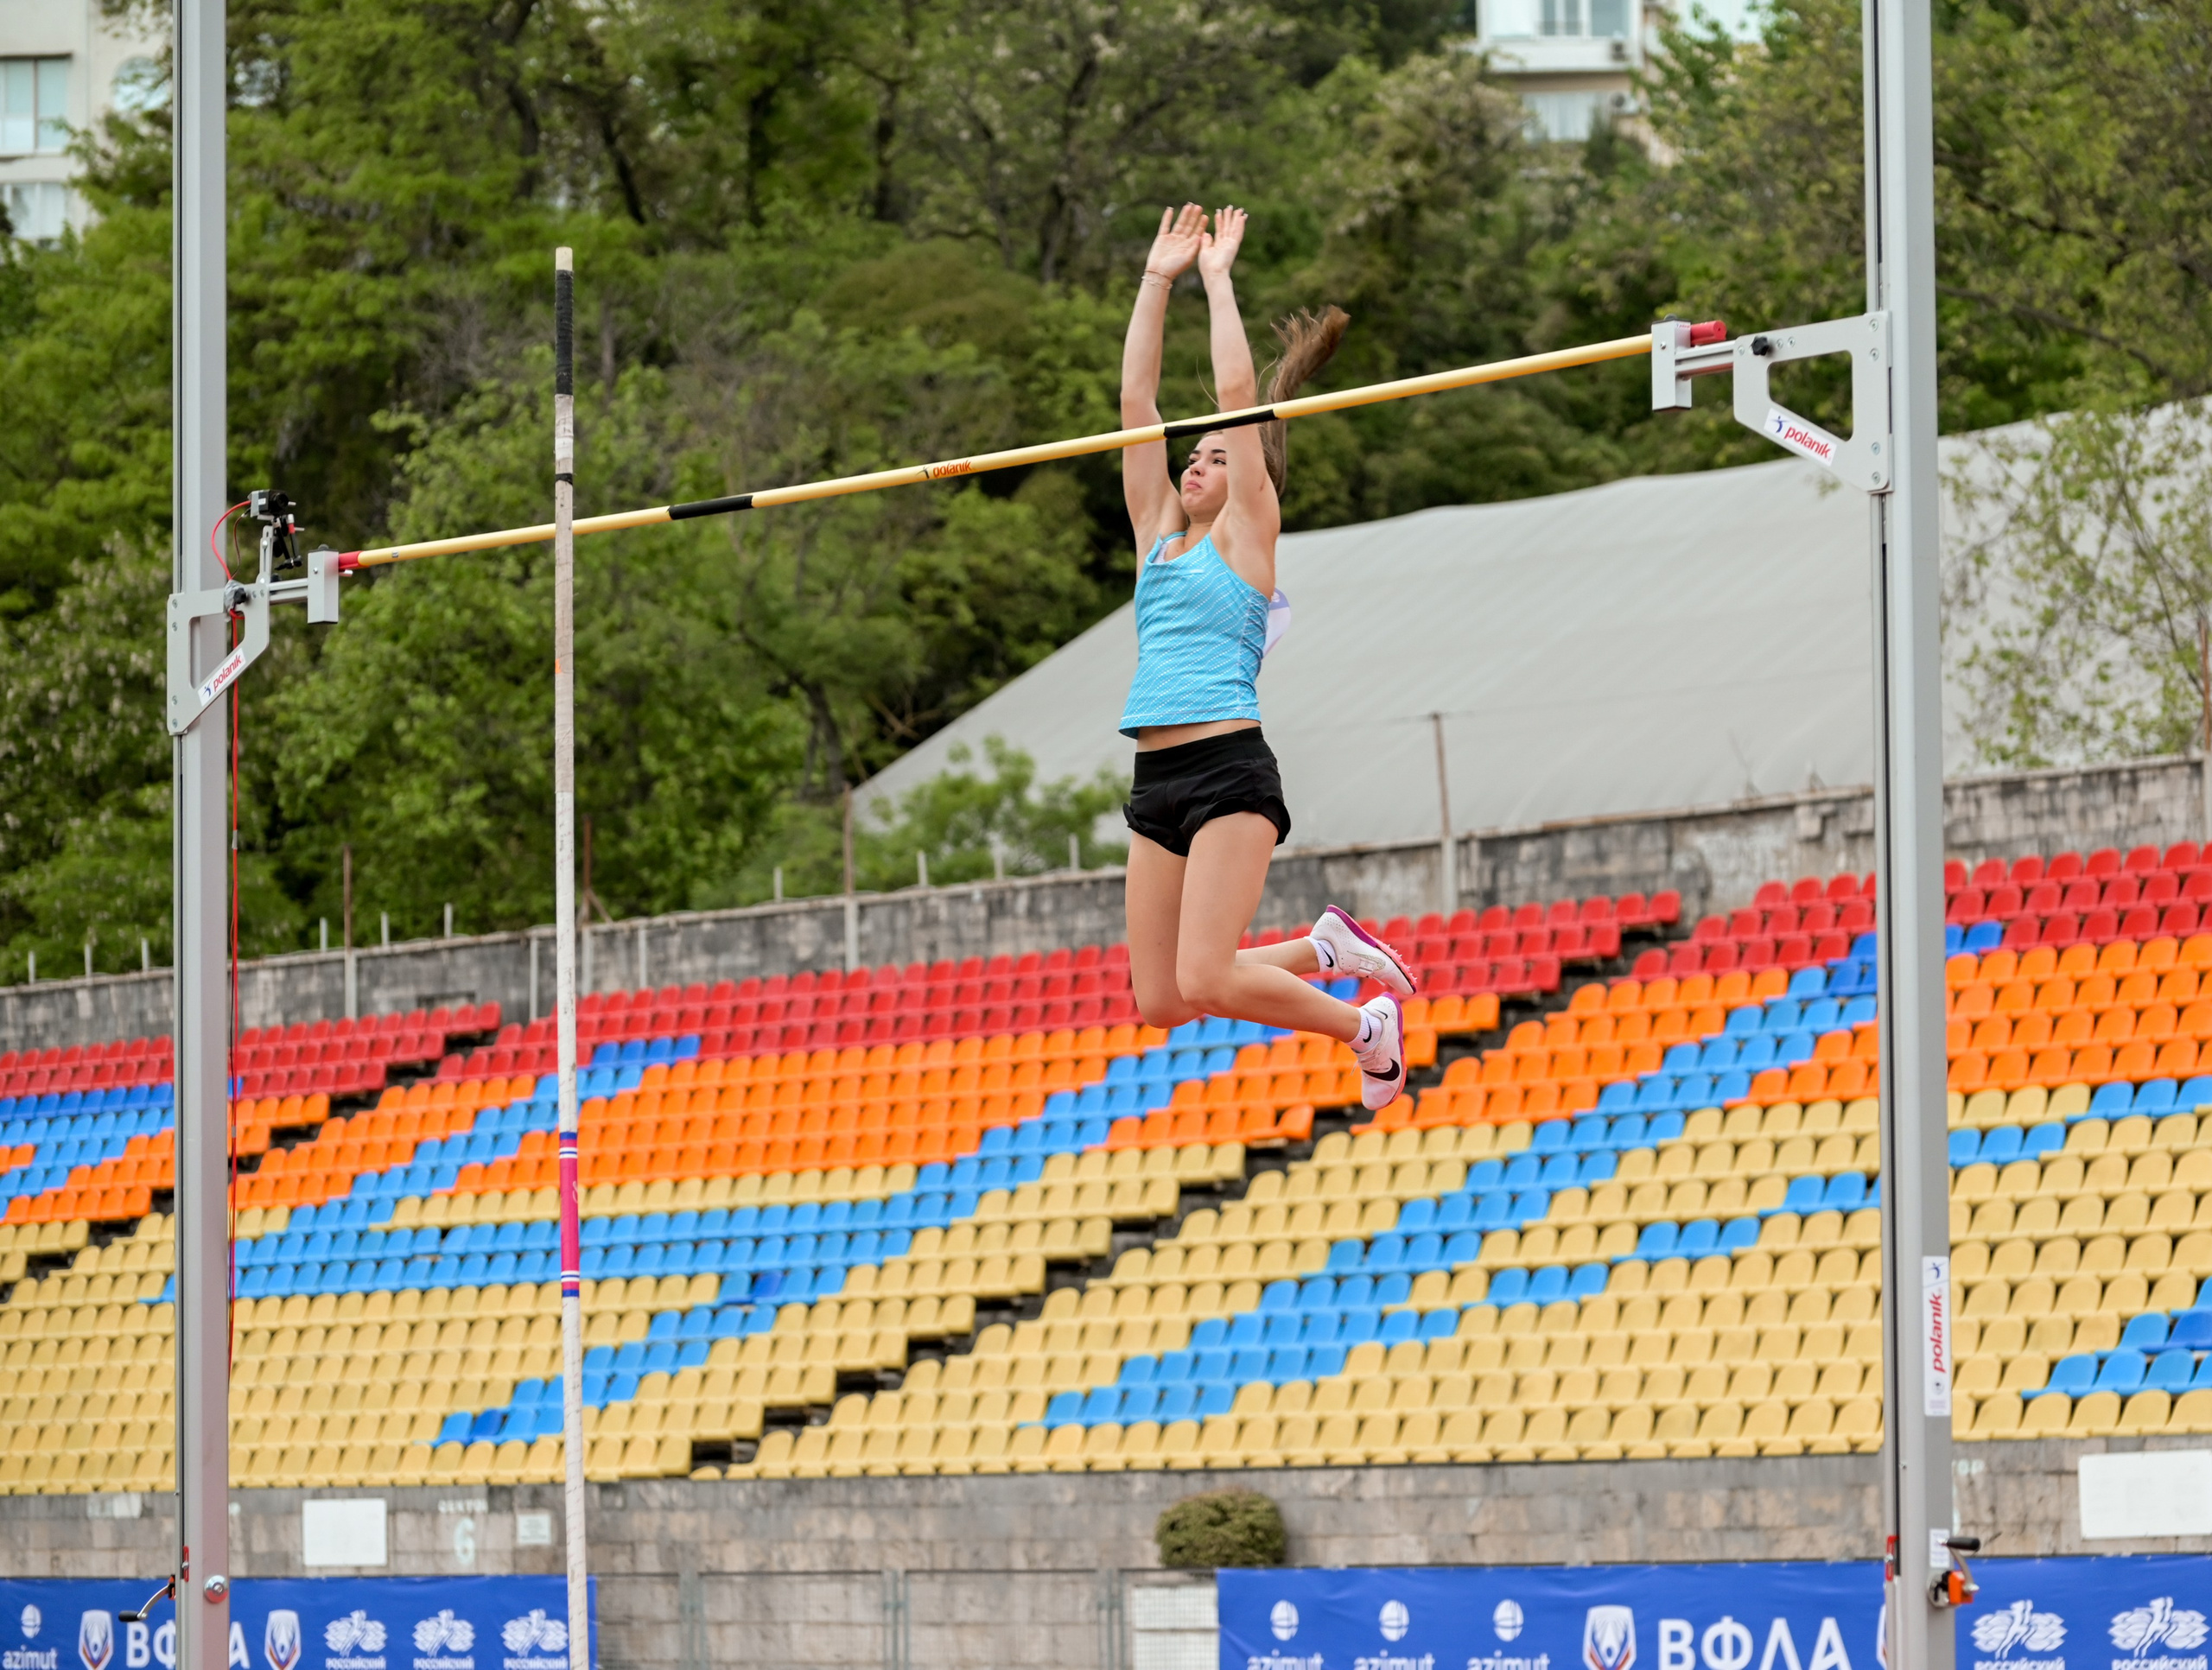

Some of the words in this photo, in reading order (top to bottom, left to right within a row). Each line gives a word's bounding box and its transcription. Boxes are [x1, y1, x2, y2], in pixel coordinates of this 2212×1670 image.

[1783, 427, 1831, 459] polanik
[213, 654, 242, 692] polanik
[1929, 1291, 1947, 1374] polanik
[454, 1517, 474, 1565] 6
[2, 1644, 58, 1670] azimut
[126, 1619, 251, 1669] ВФА
[1247, 1648, 1324, 1670] azimut
[1353, 1649, 1435, 1670] azimut
[1467, 1649, 1550, 1670] azimut
[1658, 1616, 1854, 1670] ВФЛА
